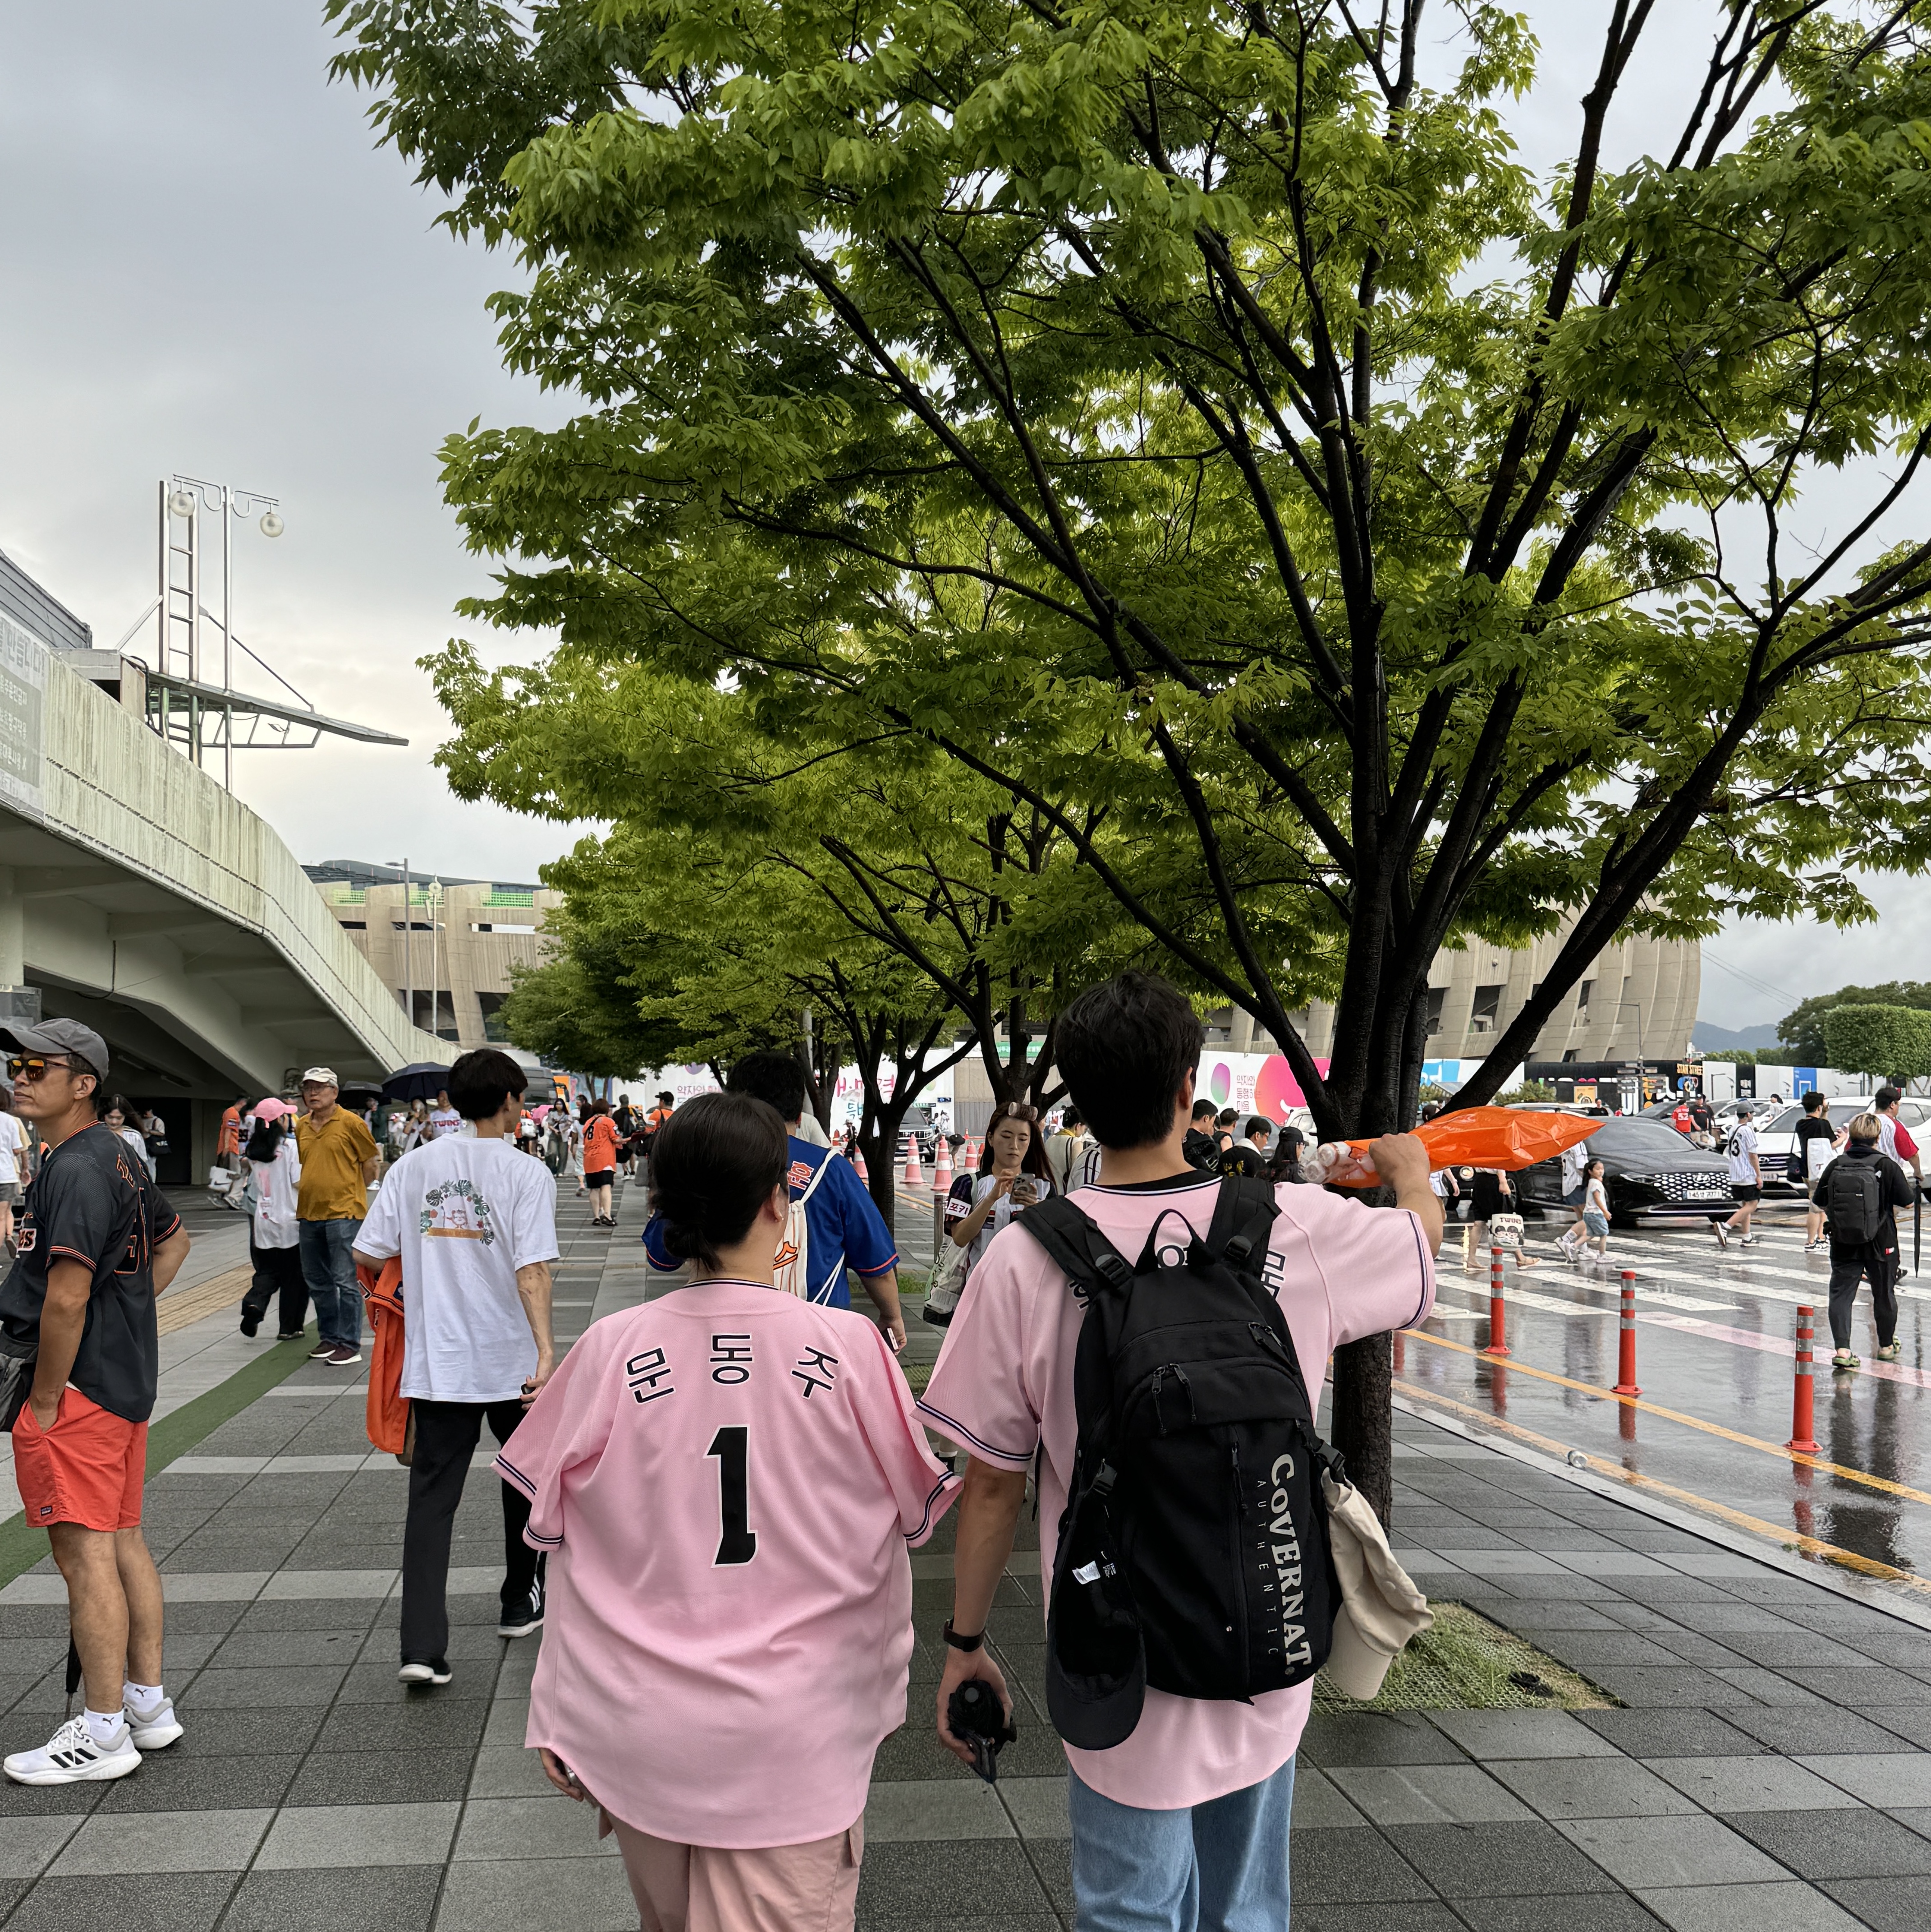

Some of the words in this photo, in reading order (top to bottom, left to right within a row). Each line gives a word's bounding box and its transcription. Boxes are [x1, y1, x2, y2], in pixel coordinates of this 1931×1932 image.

[627, 1334, 839, 1404] 문동주
[704, 1425, 757, 1568] 1
[1257, 1480, 1279, 1654] AUTHENTIC
[1269, 1454, 1312, 1665] COVERNAT
